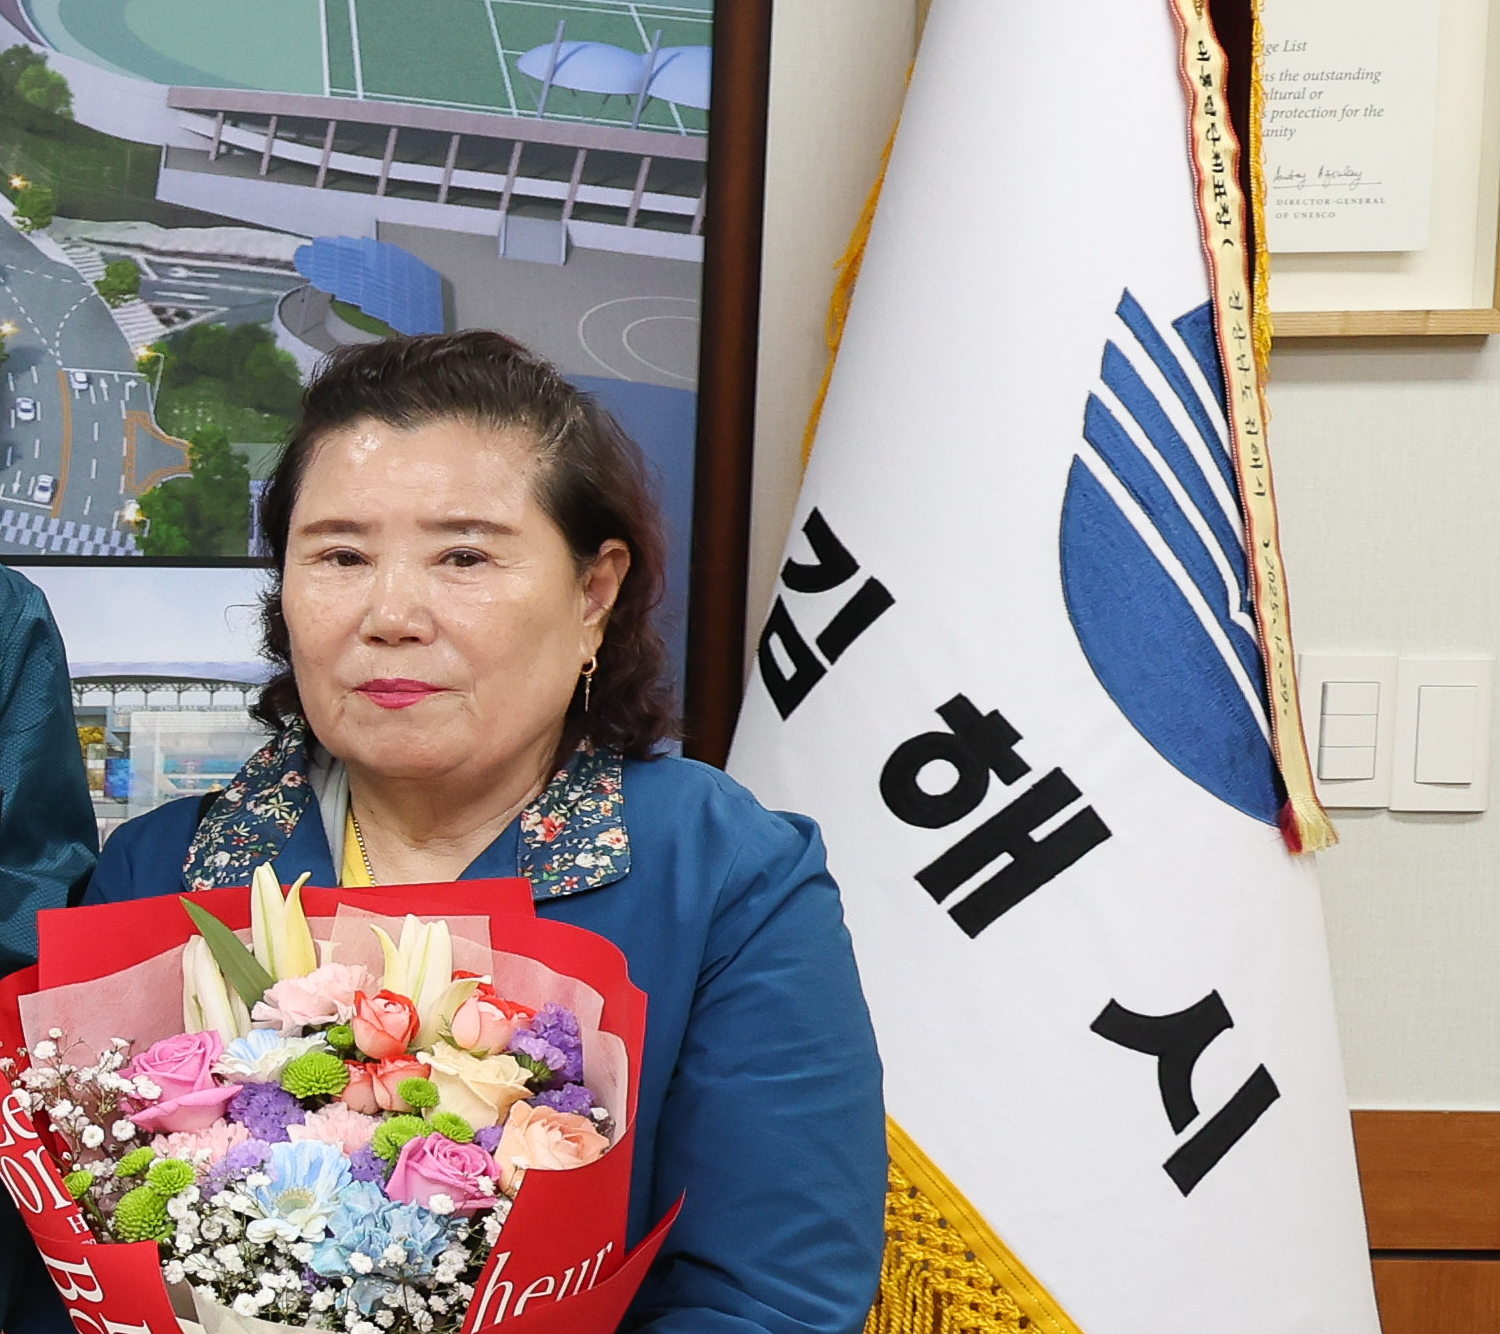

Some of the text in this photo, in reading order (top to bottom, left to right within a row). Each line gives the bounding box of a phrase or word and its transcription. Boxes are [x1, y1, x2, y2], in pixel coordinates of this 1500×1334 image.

[1283, 40, 1308, 53] List
[1278, 68, 1382, 84] the outstanding
[1308, 90, 1324, 100] or
[1270, 104, 1384, 122] protection for the
[757, 505, 1282, 1199] 김해시
